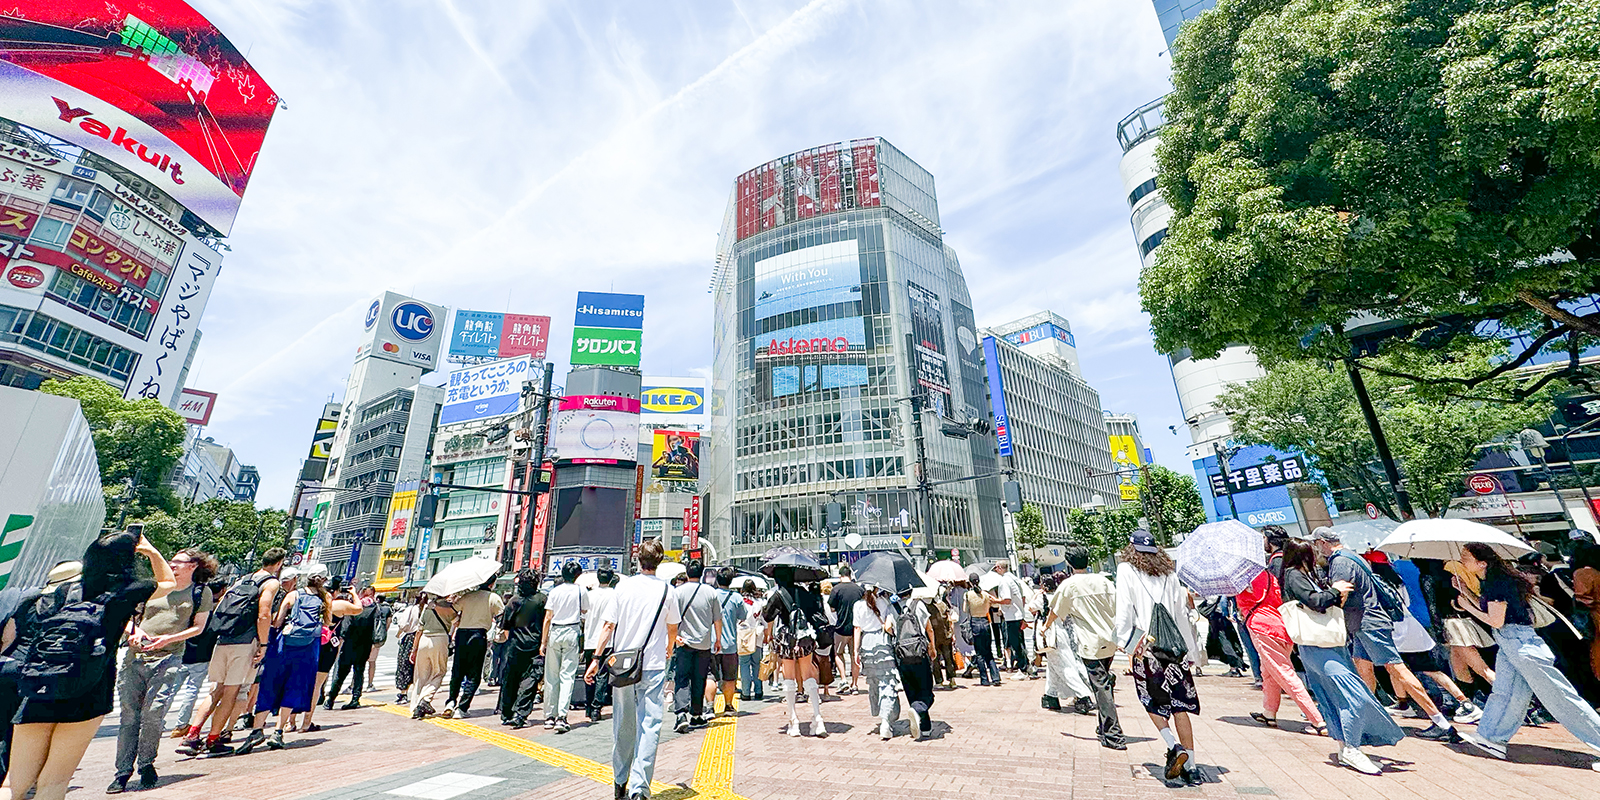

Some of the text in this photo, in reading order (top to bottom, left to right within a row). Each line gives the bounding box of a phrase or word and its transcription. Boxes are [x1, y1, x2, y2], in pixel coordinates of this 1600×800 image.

[51, 95, 186, 186] Yakult
[114, 183, 187, 236] しゃぶしゃぶバイキング
[132, 220, 177, 256] しゃぶ葉
[69, 229, 147, 280] コンタクト
[11, 273, 40, 284] ガスト
[781, 271, 806, 285] With
[808, 268, 828, 279] You
[117, 286, 152, 310] ガスト
[577, 305, 643, 318] Hisamitsu
[138, 251, 211, 400] 『マジやばくね
[395, 308, 434, 334] UC
[464, 319, 494, 333] 龍角散
[512, 323, 542, 335] 龍角散
[576, 338, 637, 355] サロンパス
[768, 336, 849, 356] Astemo
[412, 350, 432, 362] VISA
[449, 360, 527, 388] 観るってこころの
[446, 379, 510, 403] 充電というか。
[583, 397, 617, 407] Rakuten
[641, 394, 699, 406] IKEA
[995, 414, 1011, 456] SEIBU
[1213, 459, 1303, 492] 三千里薬品
[889, 517, 900, 527] 7F
[1257, 511, 1287, 524] STARTS
[751, 529, 827, 543] STARBUCKS
[1144, 537, 1150, 545] S
